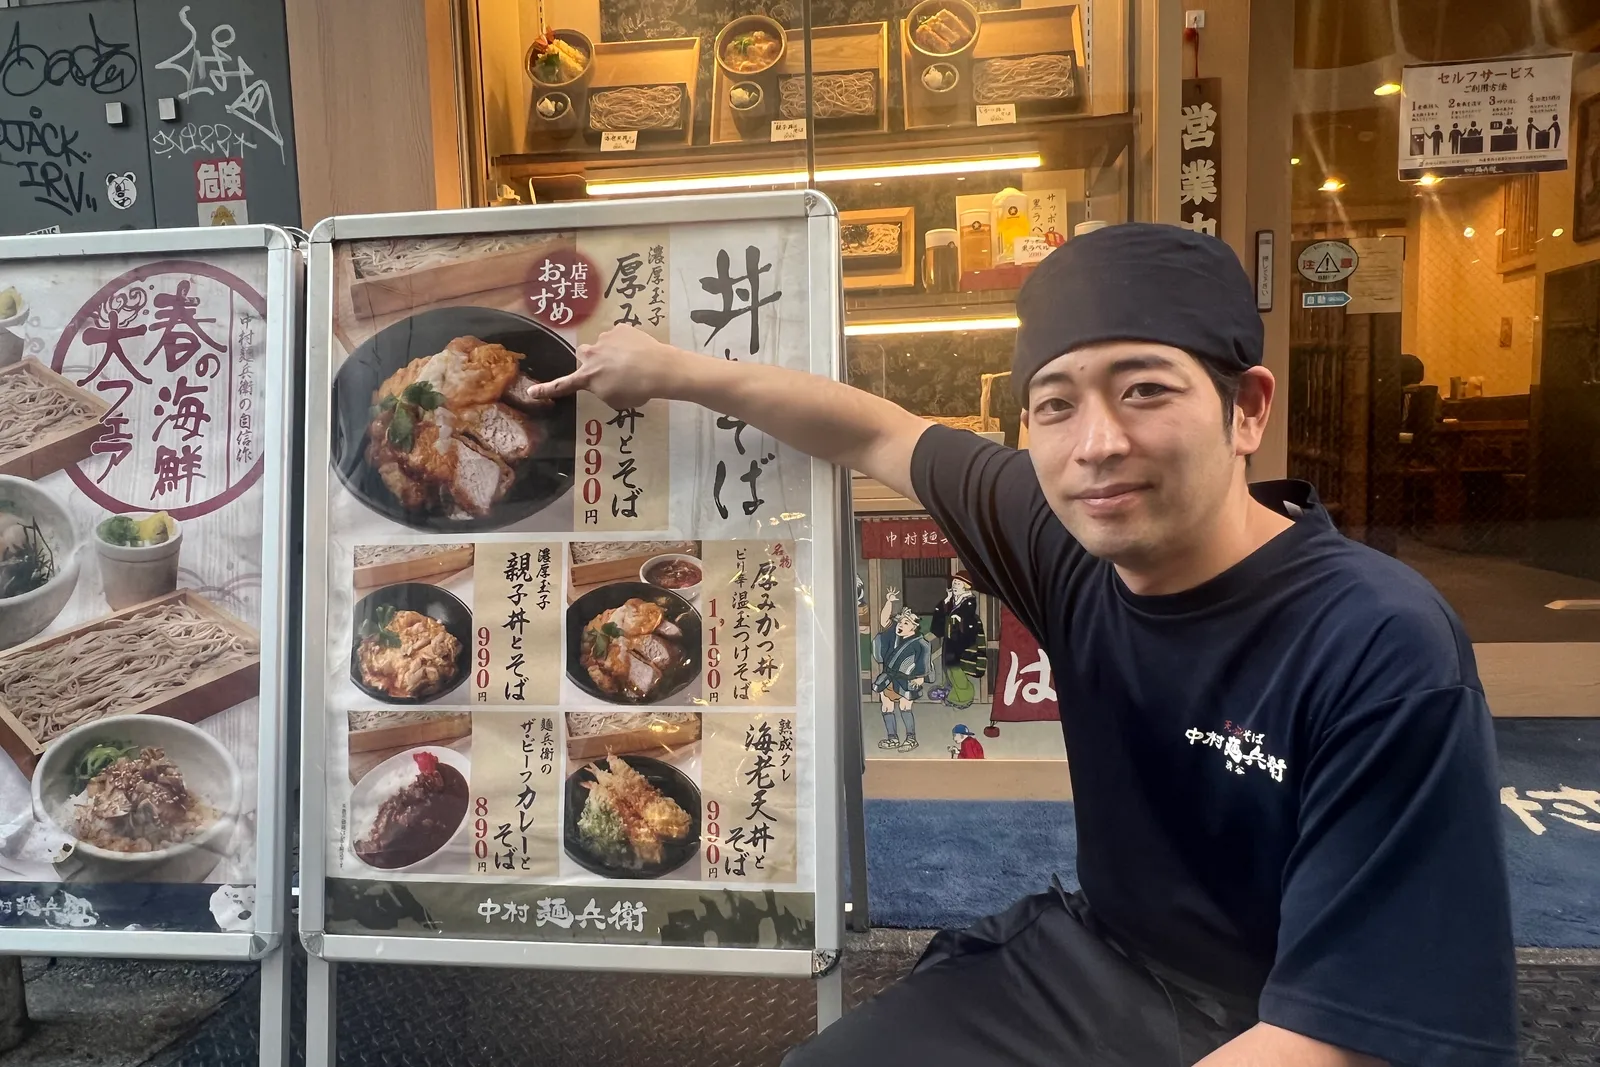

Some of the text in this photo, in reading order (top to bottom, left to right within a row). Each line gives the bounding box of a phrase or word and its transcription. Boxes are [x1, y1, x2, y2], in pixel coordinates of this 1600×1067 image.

[1438, 66, 1535, 84] セルフサービス
[1448, 98, 1456, 109] 2
[1463, 82, 1508, 93] ご利用方法
[1488, 95, 1496, 106] 3
[197, 161, 243, 199] 危険
[1031, 198, 1044, 238] 黒ラベ
[530, 259, 574, 325] おすすめ
[570, 262, 588, 299] 店長
[646, 244, 666, 327] 濃厚玉子
[76, 310, 153, 484] 大フェア
[144, 280, 228, 503] 春の海鮮
[604, 253, 646, 519] 厚み丼とそば
[582, 419, 603, 524] 990円
[536, 547, 552, 611] 濃厚玉子
[771, 542, 793, 569] 名物
[501, 552, 533, 701] 親子丼とそば
[731, 548, 752, 700] ピリ辛温玉つけそば
[751, 561, 780, 693] 厚みかつ丼と
[476, 626, 490, 702] 990円
[778, 718, 793, 782] 熟成タレ
[744, 721, 778, 869] 海老天丼と
[475, 797, 488, 872] 890円
[493, 823, 518, 870] そば
[706, 800, 720, 878] 990円
[724, 827, 751, 876] そば
